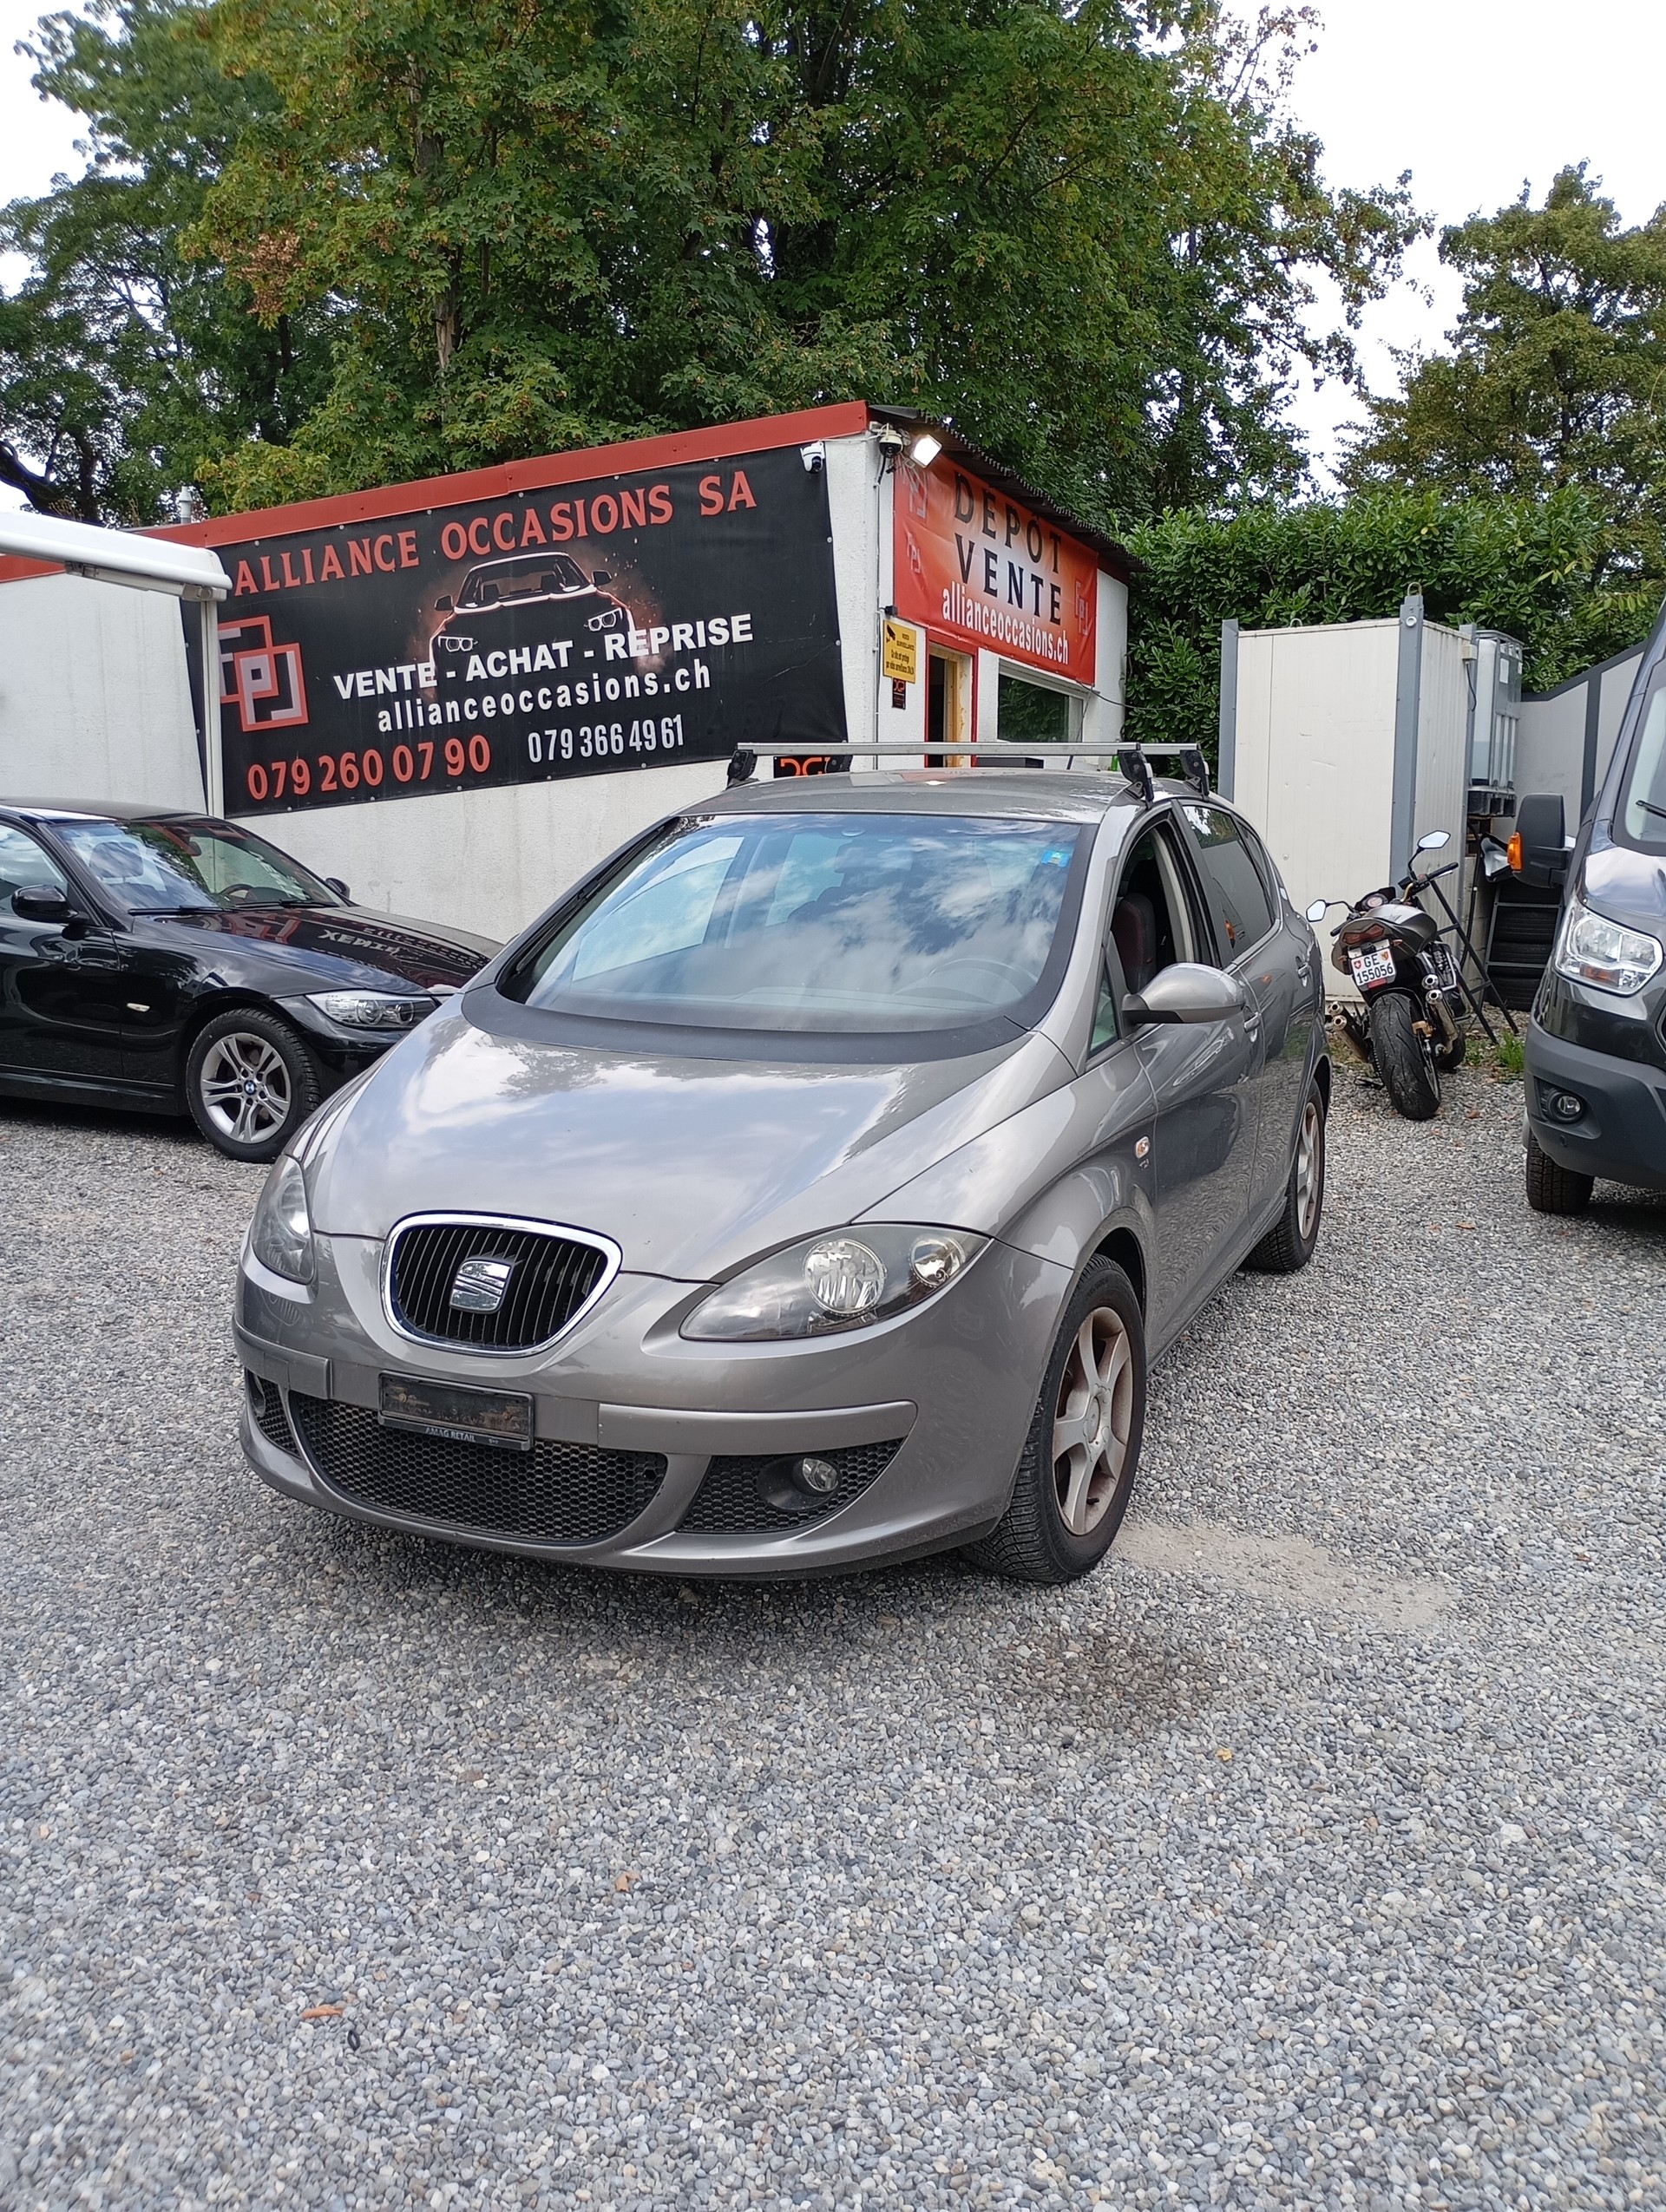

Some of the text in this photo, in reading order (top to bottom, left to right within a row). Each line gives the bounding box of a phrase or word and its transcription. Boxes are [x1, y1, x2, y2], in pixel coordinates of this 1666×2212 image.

[234, 470, 758, 597] ALLIANCE OCCASIONS SA
[954, 532, 1061, 626] VENTE
[333, 661, 437, 700] VENTE
[465, 639, 574, 682] ACHAT
[605, 613, 754, 661] REPRISE
[942, 580, 1069, 665] allianceoccasions.ch
[378, 658, 711, 733] allianceoccasions.ch
[247, 735, 491, 800] 079 260 07 90
[528, 714, 684, 762] 079 366 49 61
[1356, 962, 1394, 984] 155056
[1363, 952, 1381, 968] GE
[425, 1427, 449, 1437] AMAG
[450, 1430, 476, 1443] RETAIL
